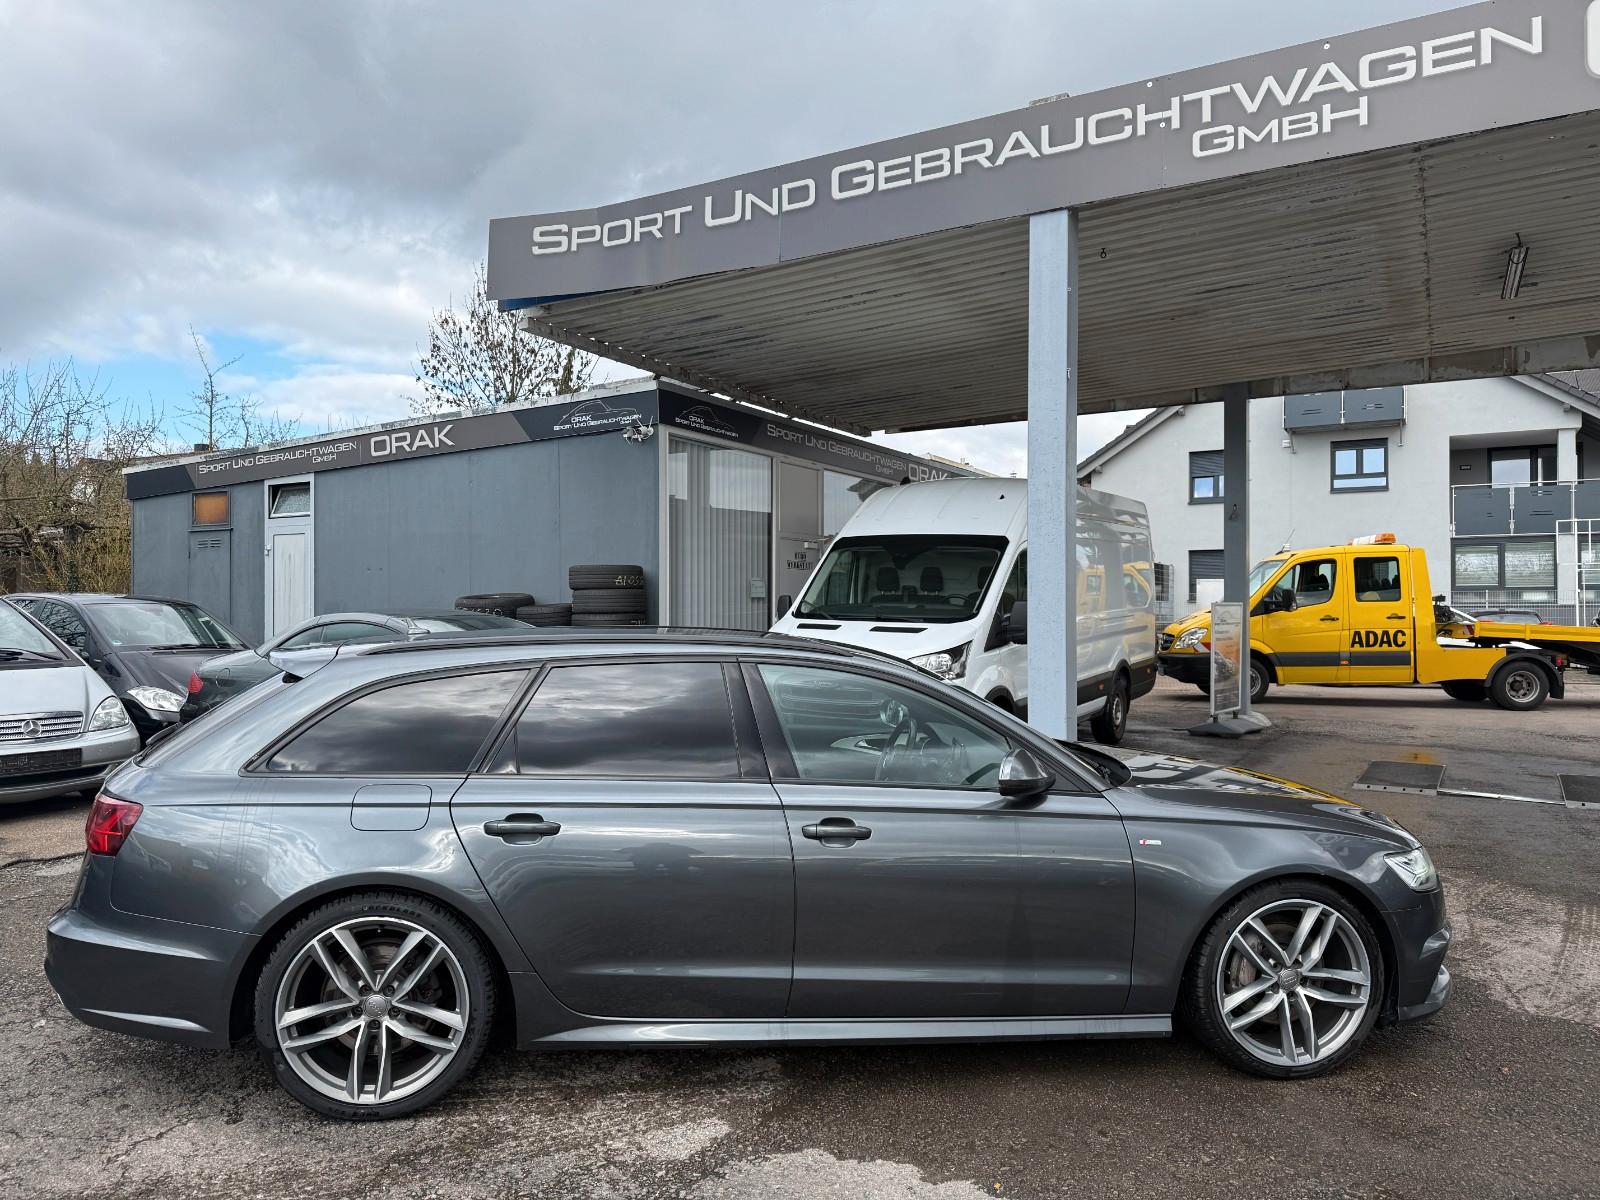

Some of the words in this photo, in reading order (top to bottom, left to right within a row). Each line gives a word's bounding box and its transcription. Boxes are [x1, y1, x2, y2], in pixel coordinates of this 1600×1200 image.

[531, 205, 693, 257] SPORT
[703, 178, 817, 229] UND
[830, 15, 1544, 202] GEBRAUCHTWAGEN
[571, 414, 593, 424] ORAK
[370, 424, 456, 457] ORAK
[767, 424, 804, 442] SPORT
[805, 433, 827, 450] UND
[828, 441, 907, 471] GEBRAUCHTWAGEN
[198, 461, 232, 475] SPORT
[232, 458, 254, 470] UND
[255, 441, 357, 465] GEBRAUCHTWAGEN
[1350, 629, 1407, 649] ADAC
